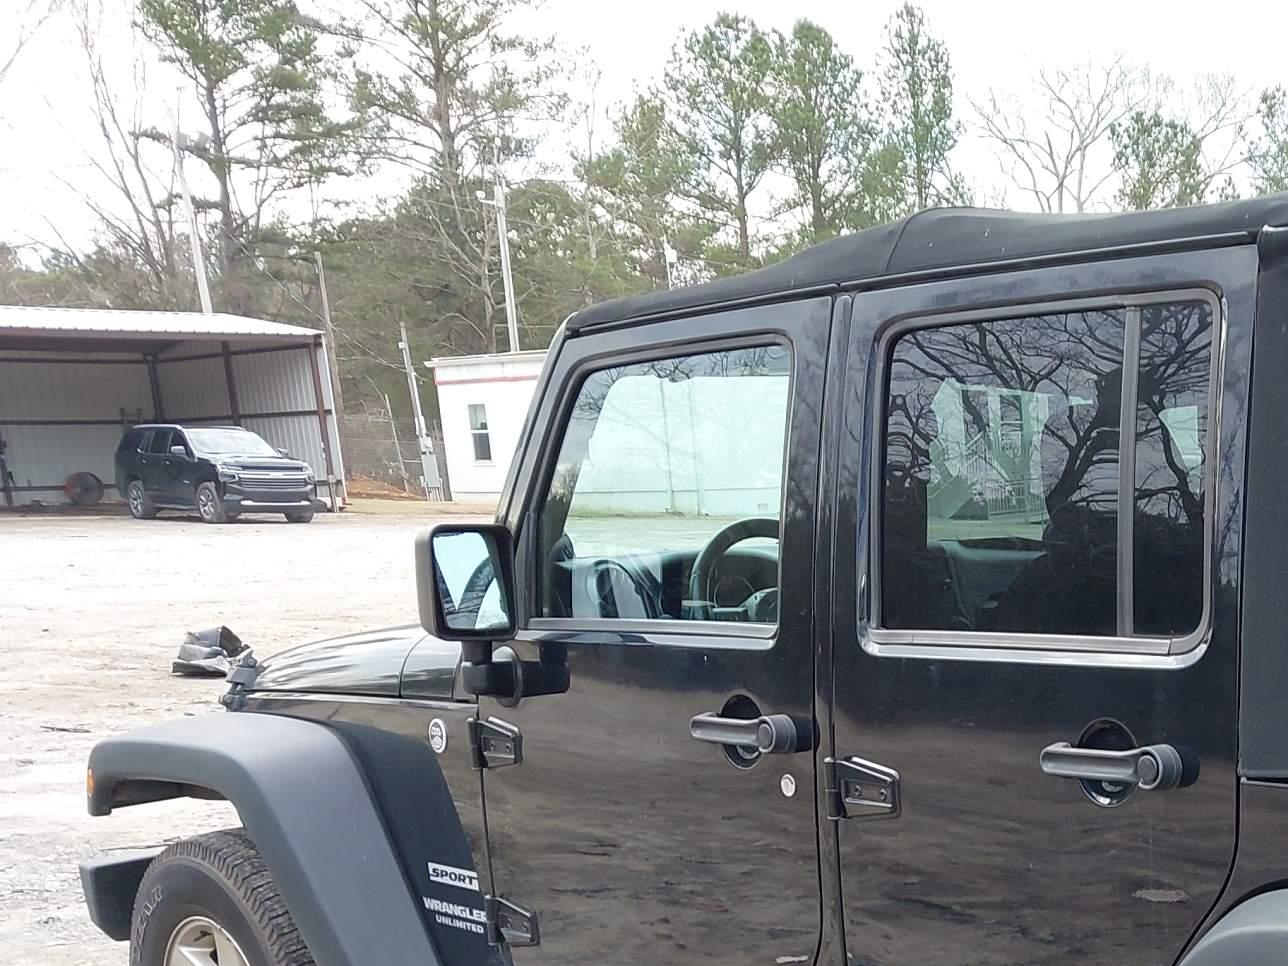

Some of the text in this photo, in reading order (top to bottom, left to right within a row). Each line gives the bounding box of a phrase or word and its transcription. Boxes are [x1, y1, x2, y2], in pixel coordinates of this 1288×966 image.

[430, 867, 478, 886] SPORT
[422, 896, 488, 923] WRANGLER
[435, 914, 484, 934] UNLIMITED
